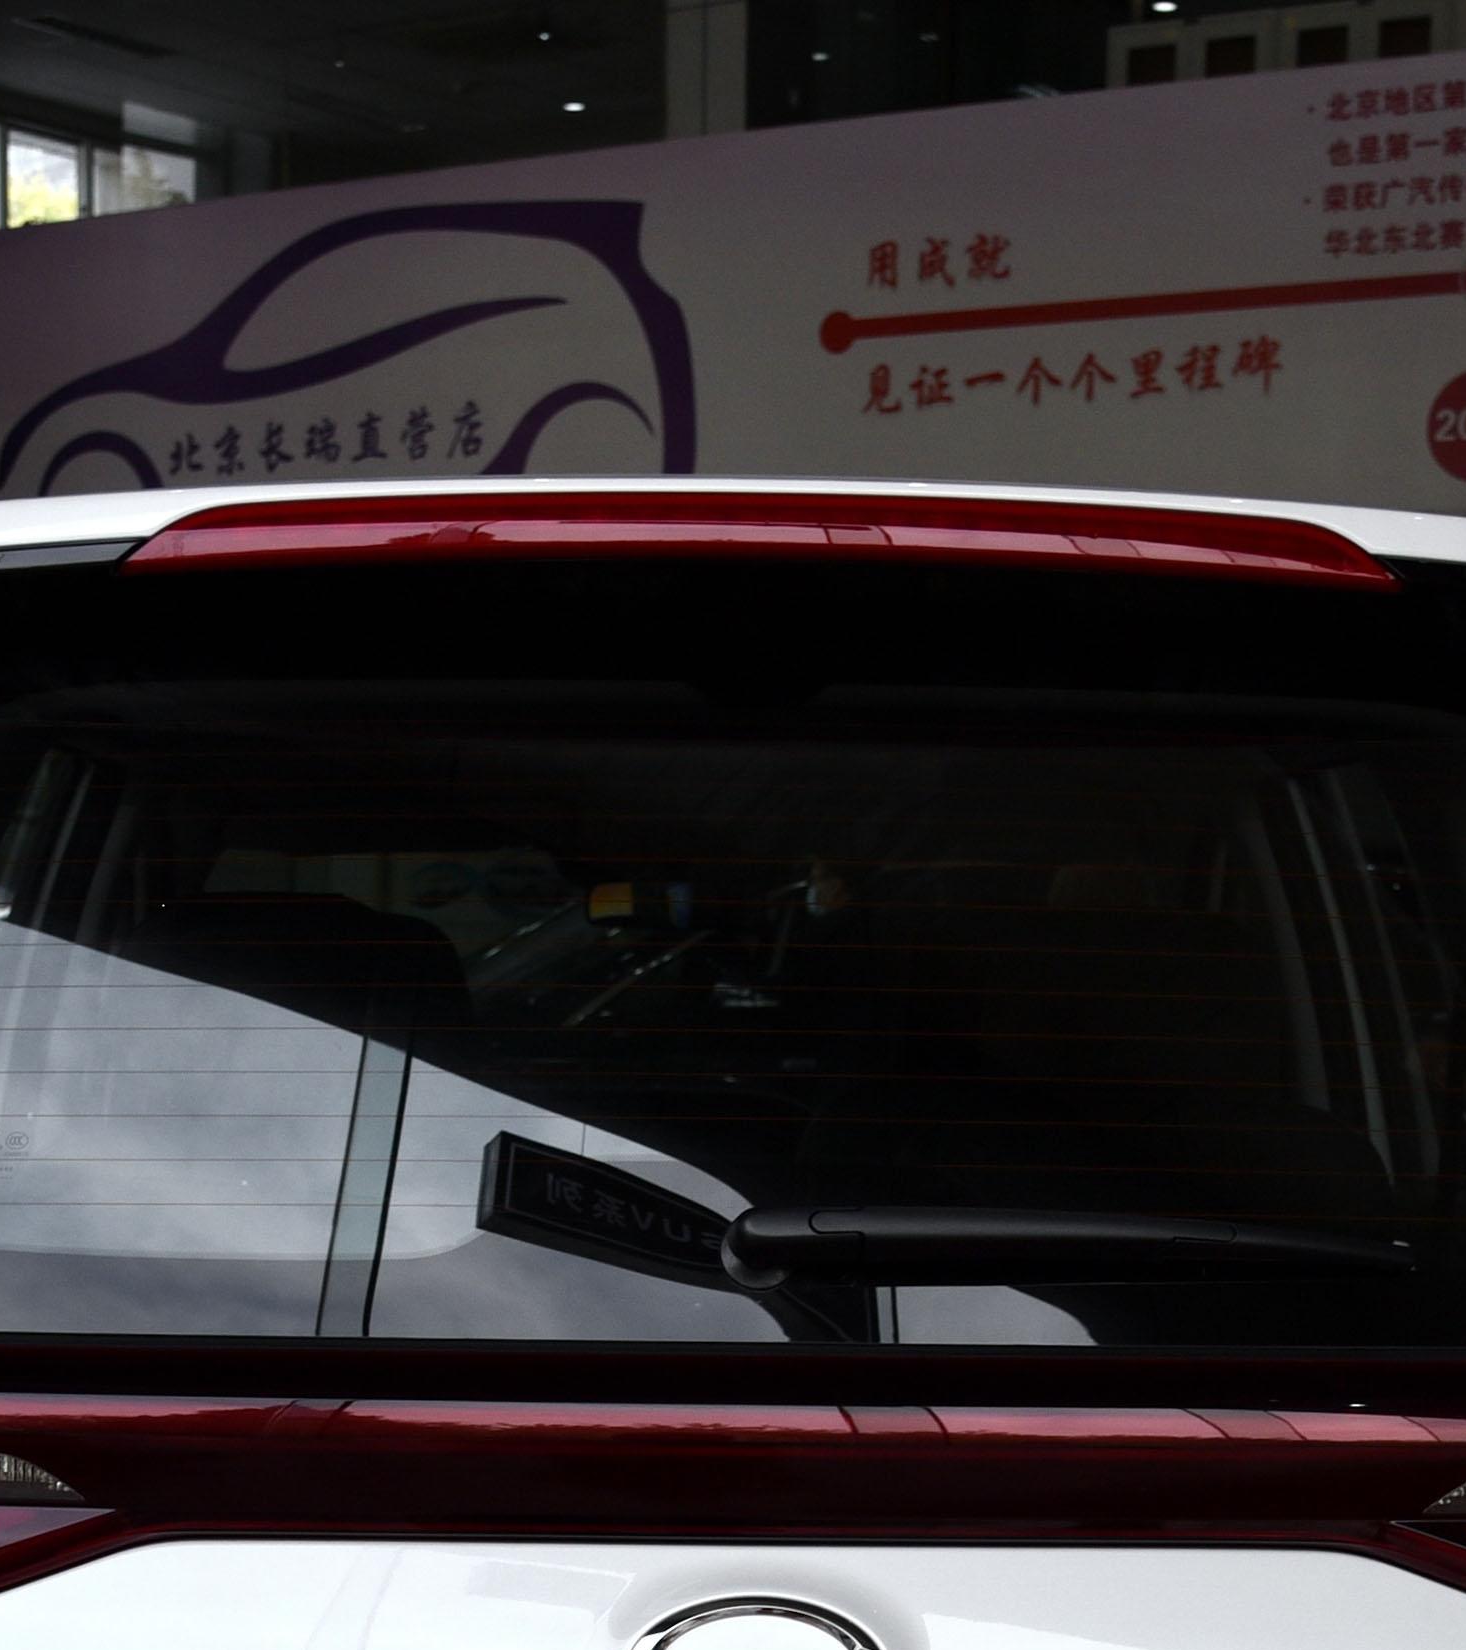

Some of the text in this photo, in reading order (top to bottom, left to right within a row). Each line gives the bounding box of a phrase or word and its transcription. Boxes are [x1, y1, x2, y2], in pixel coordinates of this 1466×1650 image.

[867, 234, 1012, 289] 用成就
[863, 335, 1283, 413] 见证一个个里程碑
[167, 400, 484, 476] 北京长瑞直营店
